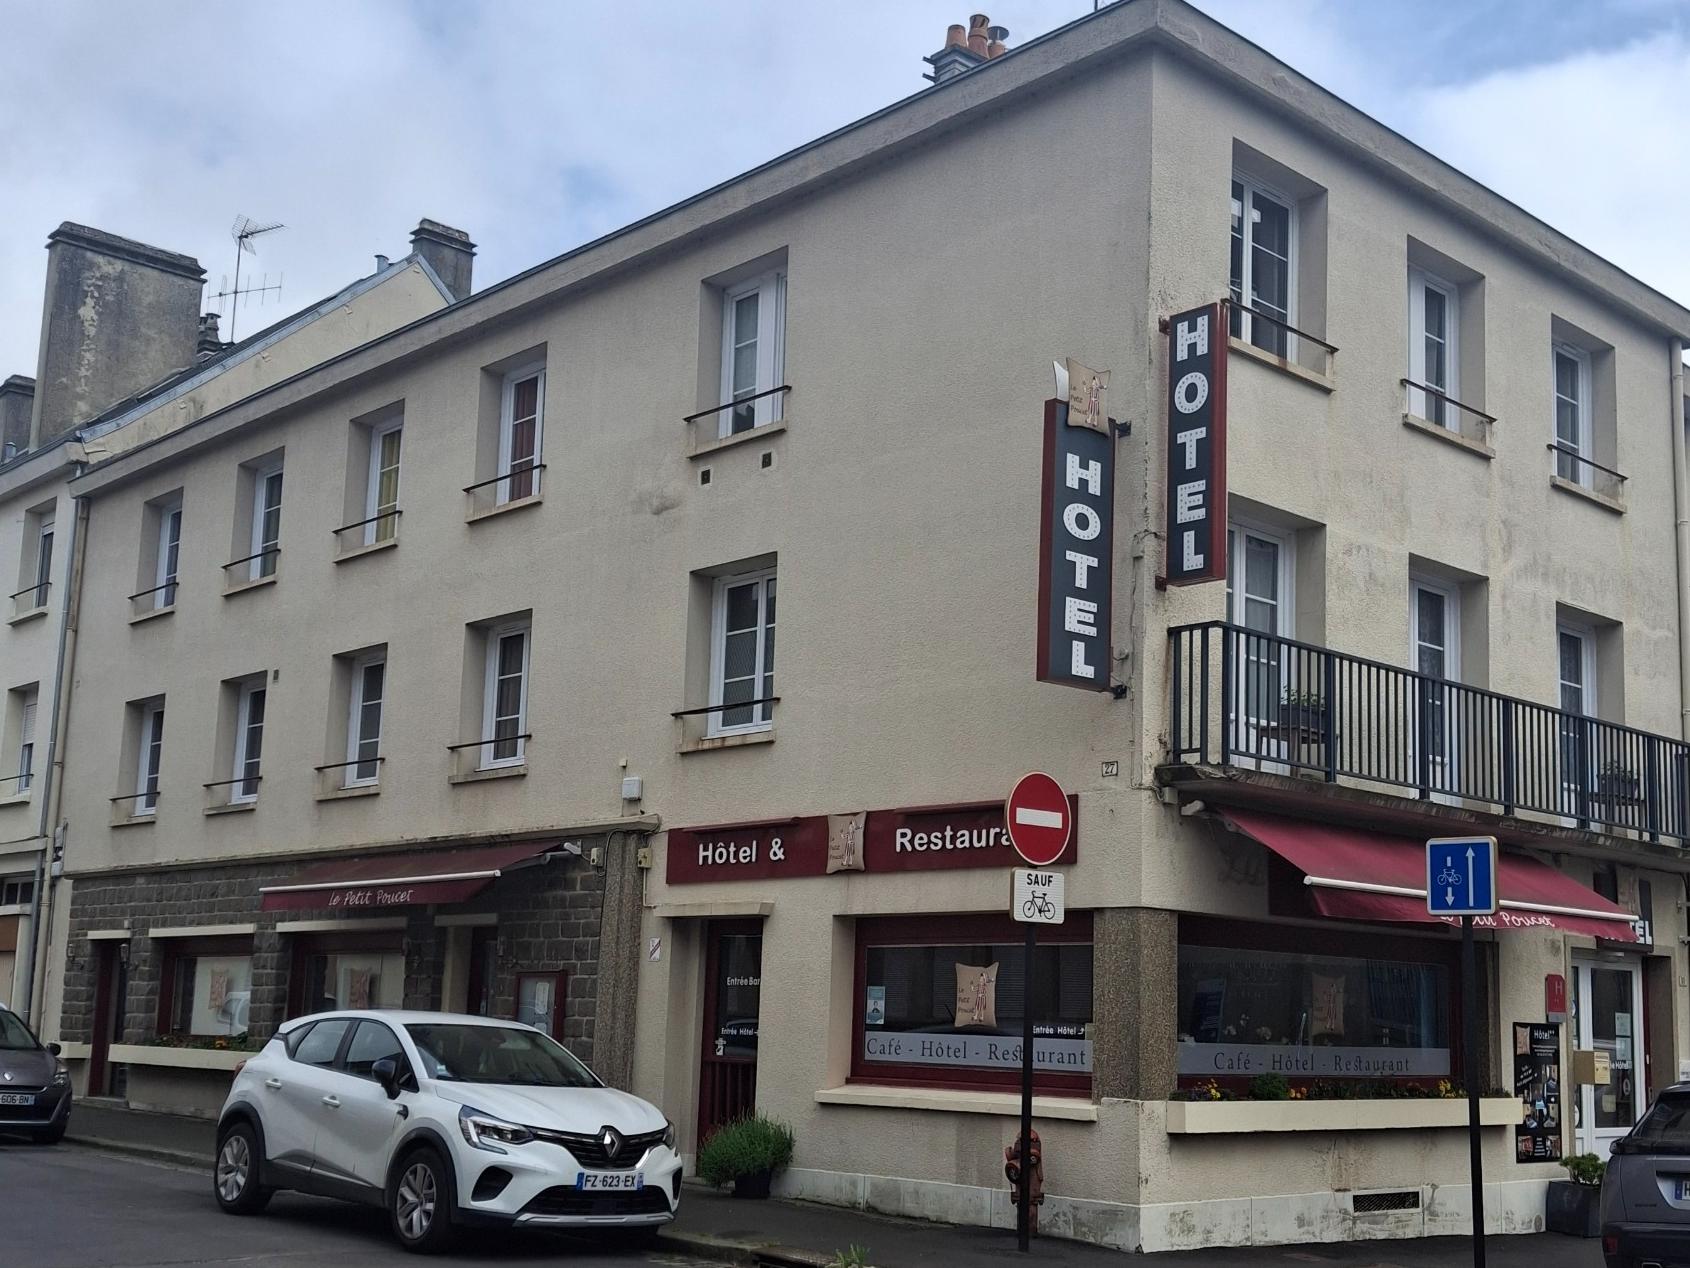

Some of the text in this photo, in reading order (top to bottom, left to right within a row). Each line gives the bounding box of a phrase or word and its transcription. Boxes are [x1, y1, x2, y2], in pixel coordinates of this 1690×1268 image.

[1174, 314, 1209, 572] HOTEL
[1062, 452, 1101, 679] HOTEL
[1104, 763, 1115, 775] 27
[698, 825, 1010, 866] Hôtel & Restaura
[1026, 872, 1054, 888] SAUF
[344, 890, 372, 906] Petit
[376, 889, 414, 905] Poucet
[726, 975, 749, 987] Entrée
[721, 1027, 754, 1036] Entrée Hôtel
[1032, 1024, 1077, 1036] Entrée Hôtel
[866, 1037, 902, 1056] Café
[921, 1040, 967, 1060] Hôtel
[987, 1043, 1087, 1066] Resturant
[1213, 1051, 1251, 1071] Café
[1271, 1053, 1315, 1072] Hôtel
[1333, 1055, 1410, 1073] Restaurant
[1, 1094, 30, 1105] 606-BN
